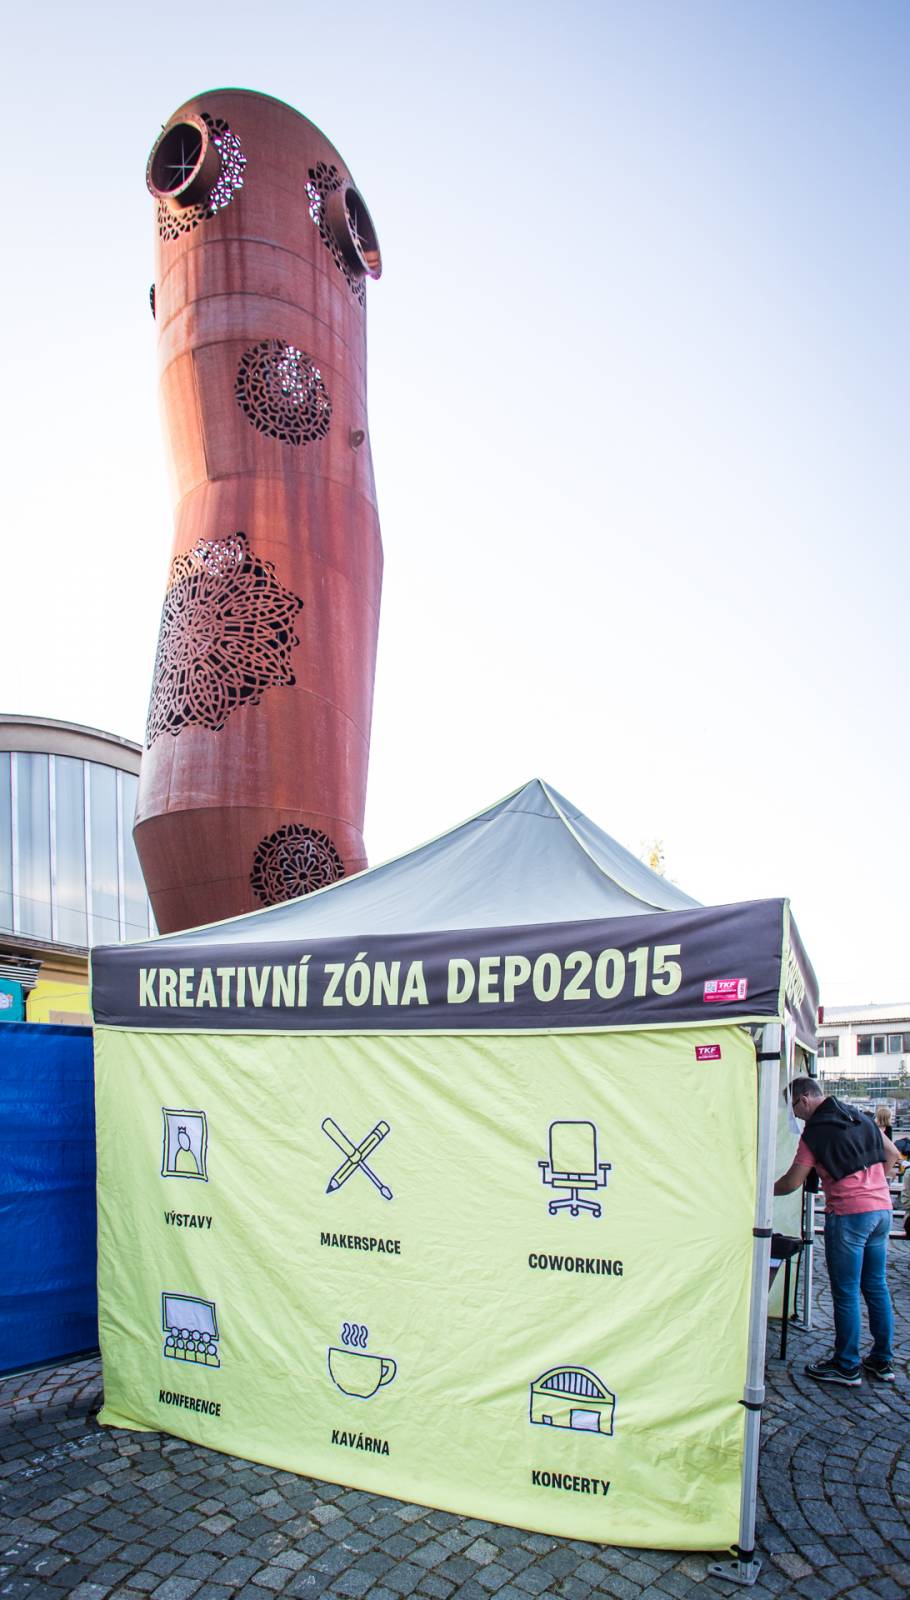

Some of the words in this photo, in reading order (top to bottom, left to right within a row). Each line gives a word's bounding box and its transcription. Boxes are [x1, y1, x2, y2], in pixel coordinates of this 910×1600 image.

[139, 954, 312, 1009] KREATIVNÍ
[323, 952, 429, 1007] ZÓNA
[446, 943, 682, 1004] DEPO2015
[163, 1210, 213, 1230] VÝSTAVY
[320, 1232, 401, 1255] MAKERSPACE
[528, 1253, 624, 1276] COWORKING
[158, 1389, 222, 1416] KONFERENCE
[331, 1429, 390, 1456] KAVÁRNA
[531, 1470, 611, 1497] KONCERTY
